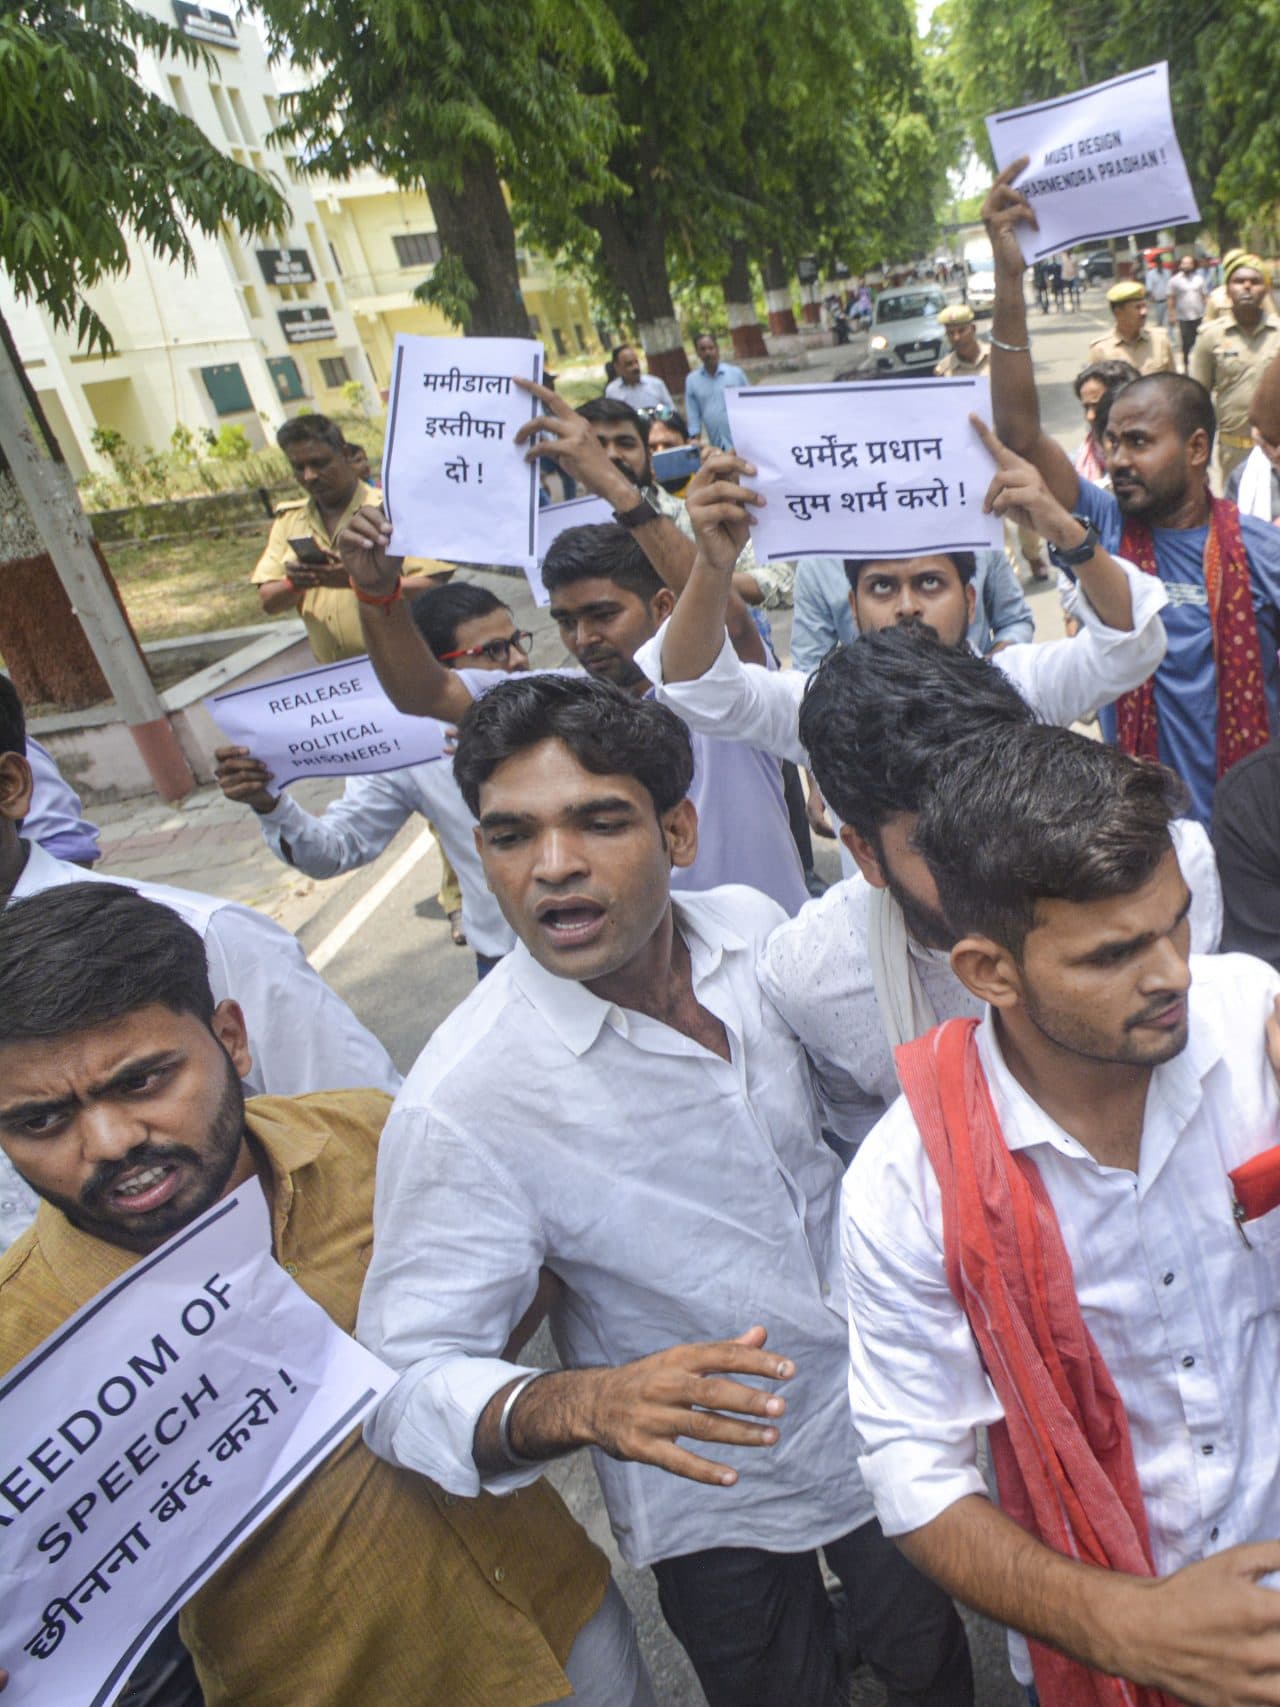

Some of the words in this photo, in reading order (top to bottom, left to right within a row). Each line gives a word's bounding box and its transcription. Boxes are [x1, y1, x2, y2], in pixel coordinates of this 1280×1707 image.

[1045, 144, 1074, 166] MUST
[1078, 130, 1122, 157] RESIGN
[1098, 150, 1158, 181] PRADHAN
[423, 367, 512, 394] ममीडाला
[425, 410, 506, 440] इस्तीफा
[791, 435, 858, 468] धर्मेंद्र
[865, 437, 943, 464] प्रधान
[444, 455, 470, 484] दो
[477, 462, 484, 484] !
[785, 494, 831, 521] तुम
[840, 481, 888, 512] शर्म
[896, 478, 949, 510] करो
[959, 482, 967, 506] !
[269, 678, 363, 714] REALEASE
[310, 709, 344, 728] ALL
[288, 722, 383, 755] POLITICAL
[292, 741, 391, 767] PRISONERS
[394, 739, 401, 751] !
[0, 1333, 181, 1528] EEDOM
[181, 1272, 233, 1337] OF
[36, 1373, 220, 1565] SPEECH
[24, 1522, 152, 1660] छीनना
[149, 1460, 213, 1523] बंद
[208, 1387, 280, 1462] करो
[278, 1368, 299, 1395] !
